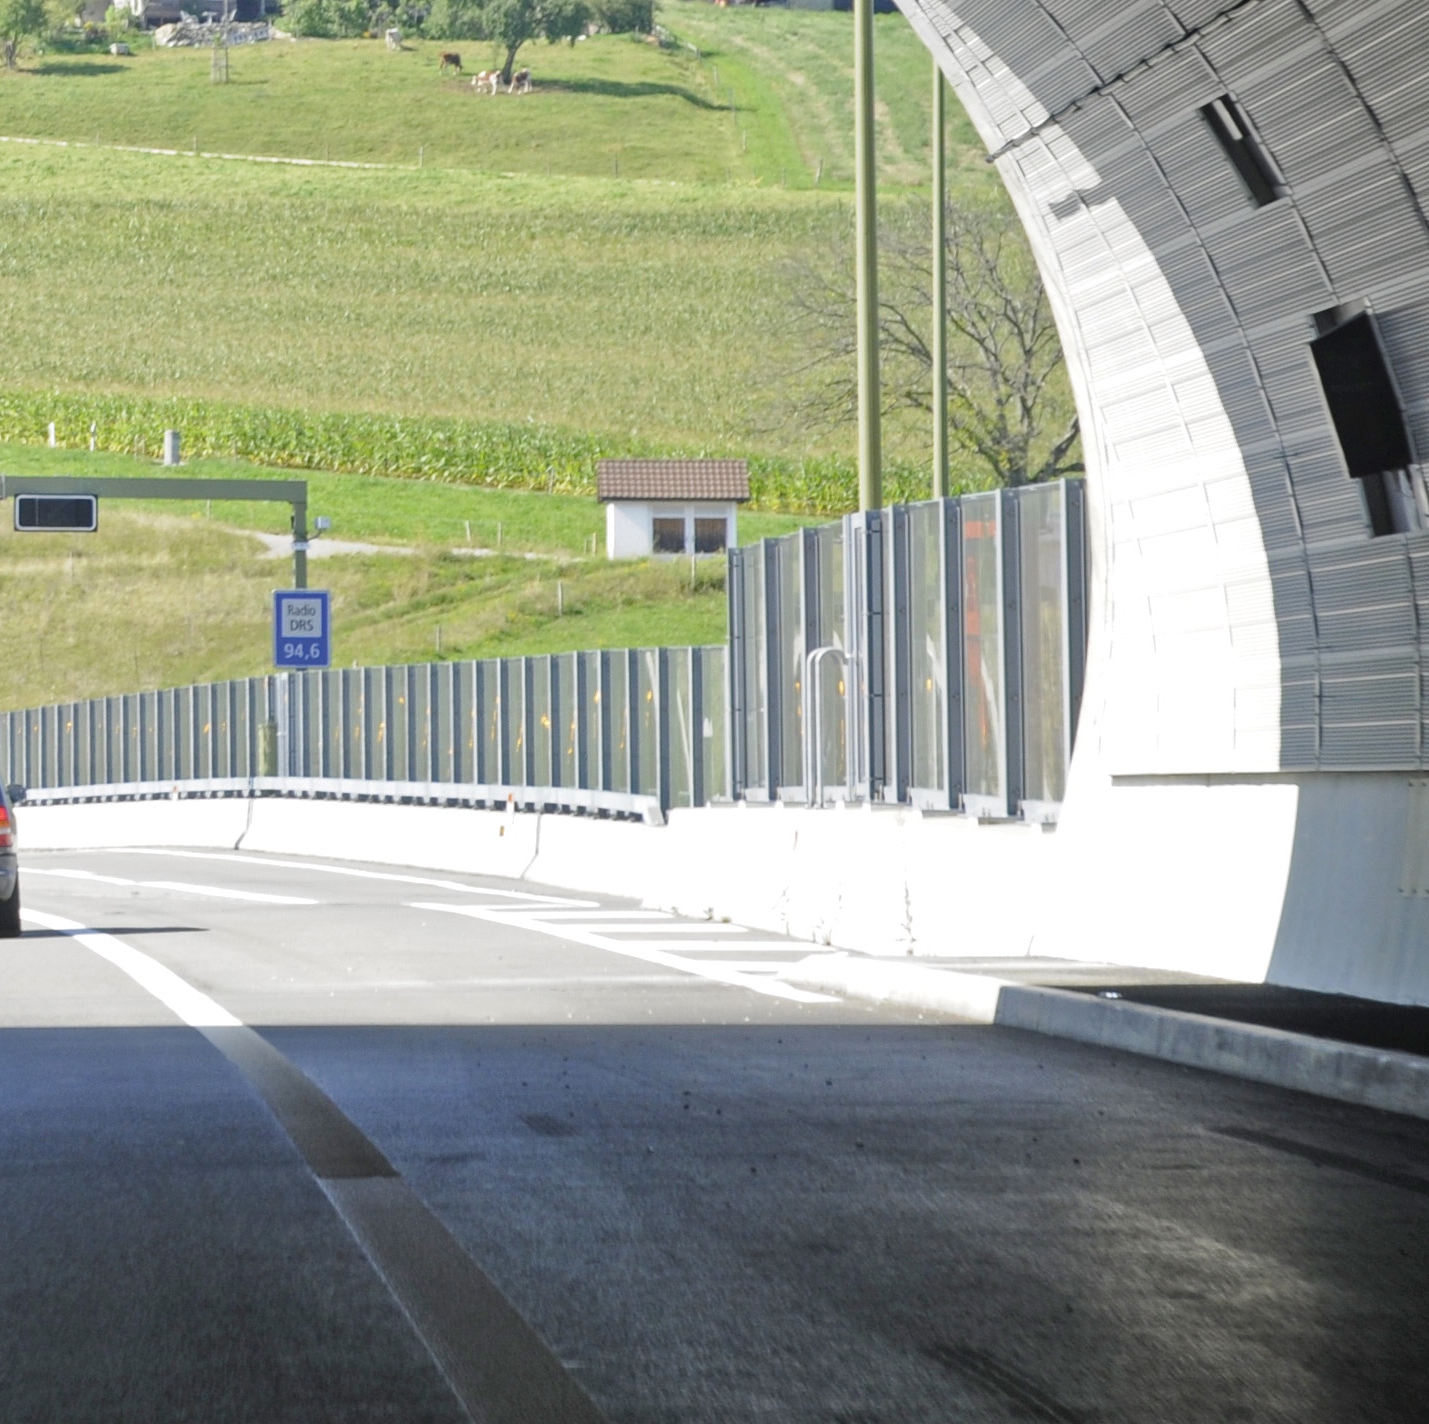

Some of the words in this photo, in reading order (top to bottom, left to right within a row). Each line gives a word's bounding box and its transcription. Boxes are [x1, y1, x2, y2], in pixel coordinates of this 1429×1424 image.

[288, 604, 316, 616] Radio
[290, 619, 314, 631] DRS
[284, 643, 320, 661] 94,6
